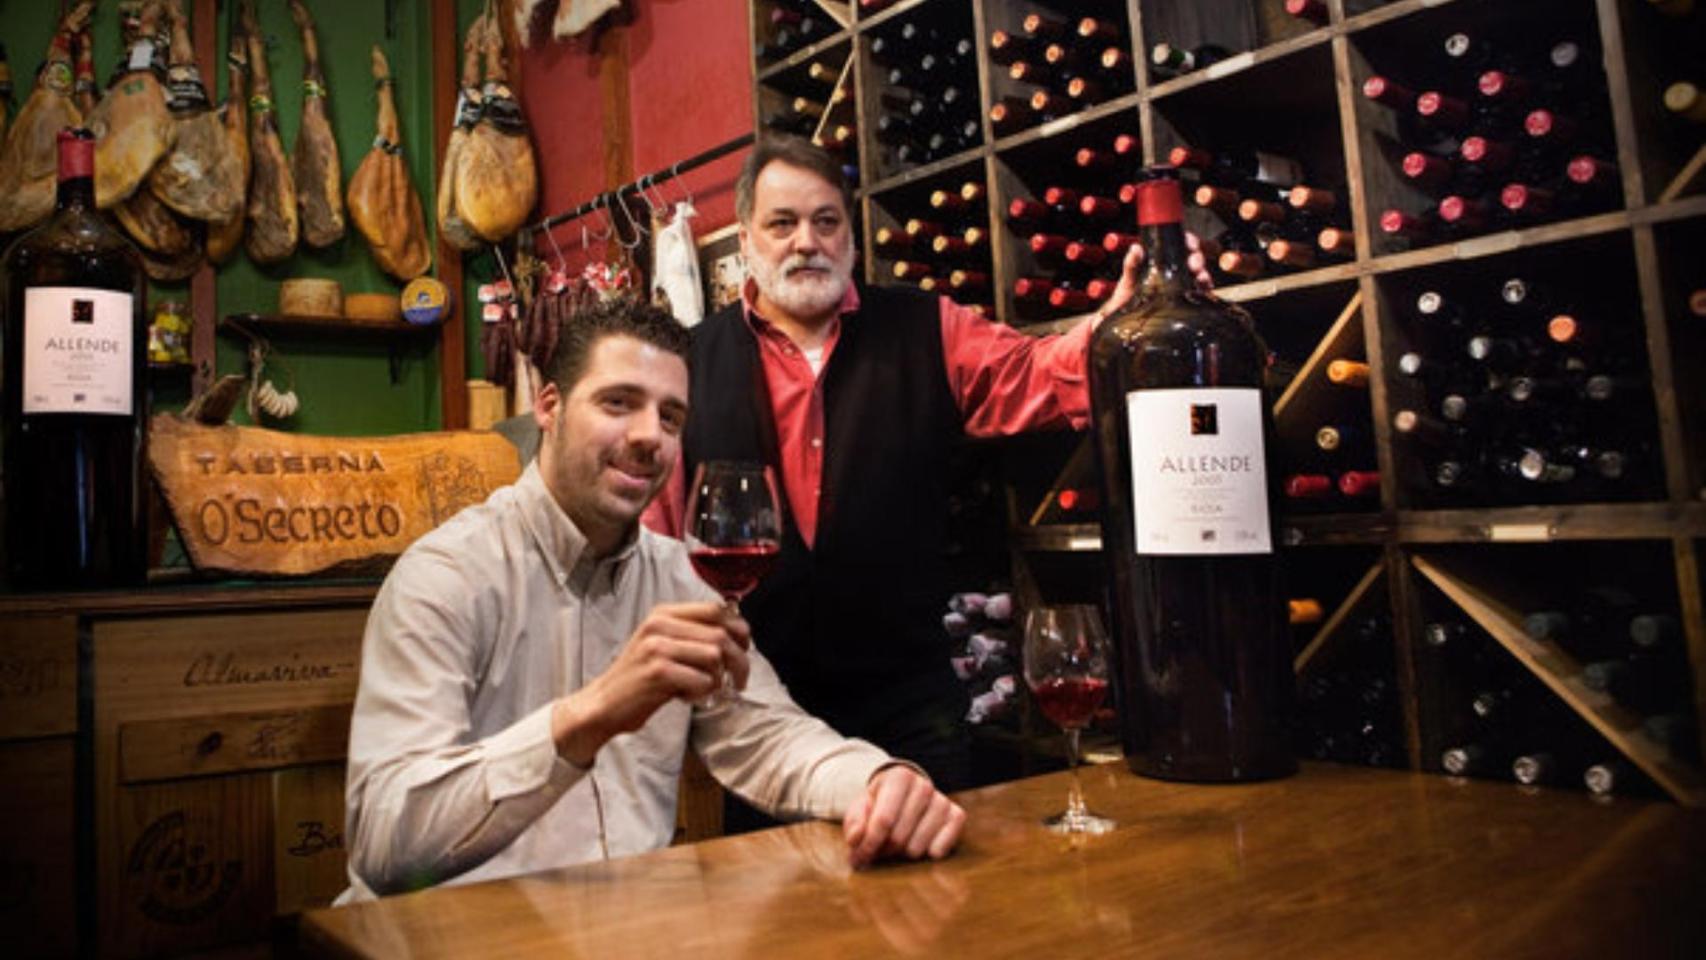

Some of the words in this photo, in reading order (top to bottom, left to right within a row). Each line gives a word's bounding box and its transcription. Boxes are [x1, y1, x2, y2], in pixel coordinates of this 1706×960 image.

[44, 336, 119, 354] ALLENDE
[196, 452, 386, 476] TABERNA
[1160, 455, 1253, 473] ALLENDE
